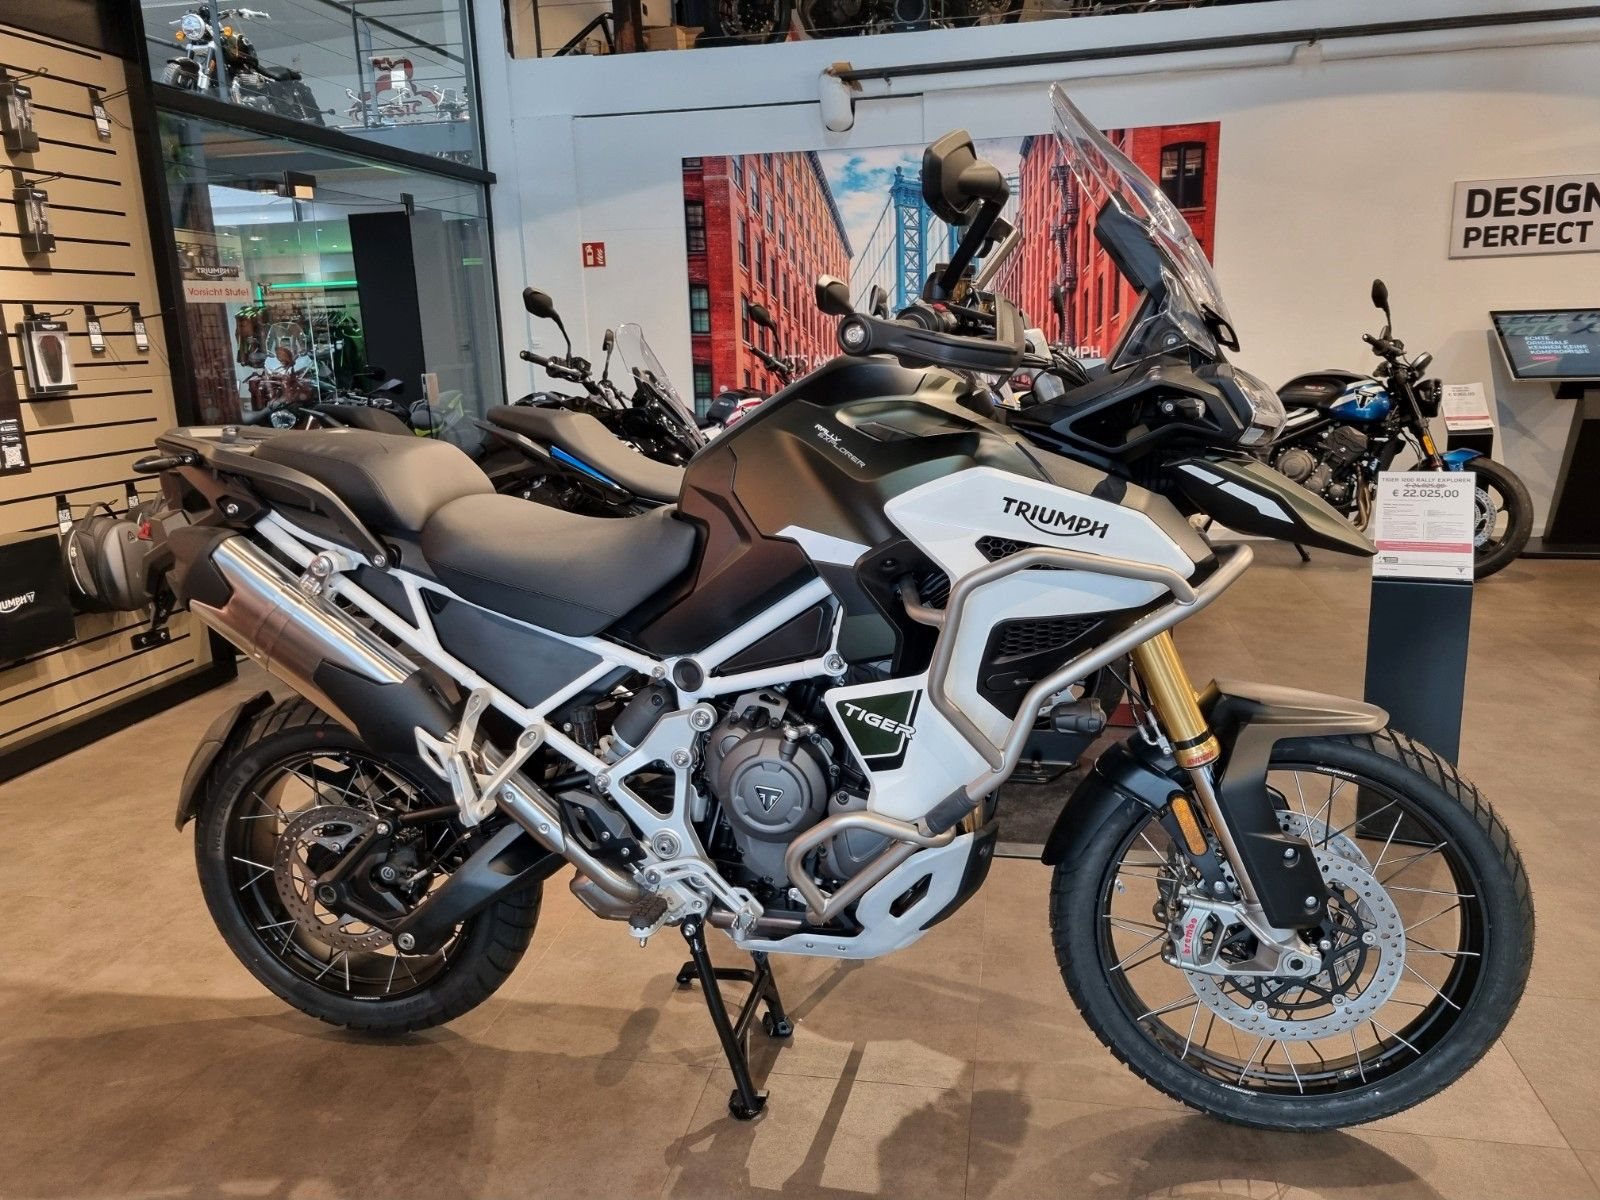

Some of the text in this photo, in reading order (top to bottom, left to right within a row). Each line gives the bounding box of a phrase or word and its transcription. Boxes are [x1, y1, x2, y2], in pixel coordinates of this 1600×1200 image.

[1465, 182, 1600, 219] DESIGN
[1462, 220, 1594, 249] PERFECT
[195, 266, 230, 277] TRIUMPH
[187, 287, 223, 297] Vorsicht
[814, 423, 842, 442] RALLY
[817, 432, 866, 468] EXPLORER
[1392, 489, 1459, 498] € 22.025,00
[1002, 496, 1110, 539] TRIUMPH
[844, 702, 917, 740] TIGER
[1183, 917, 1198, 955] brembo
